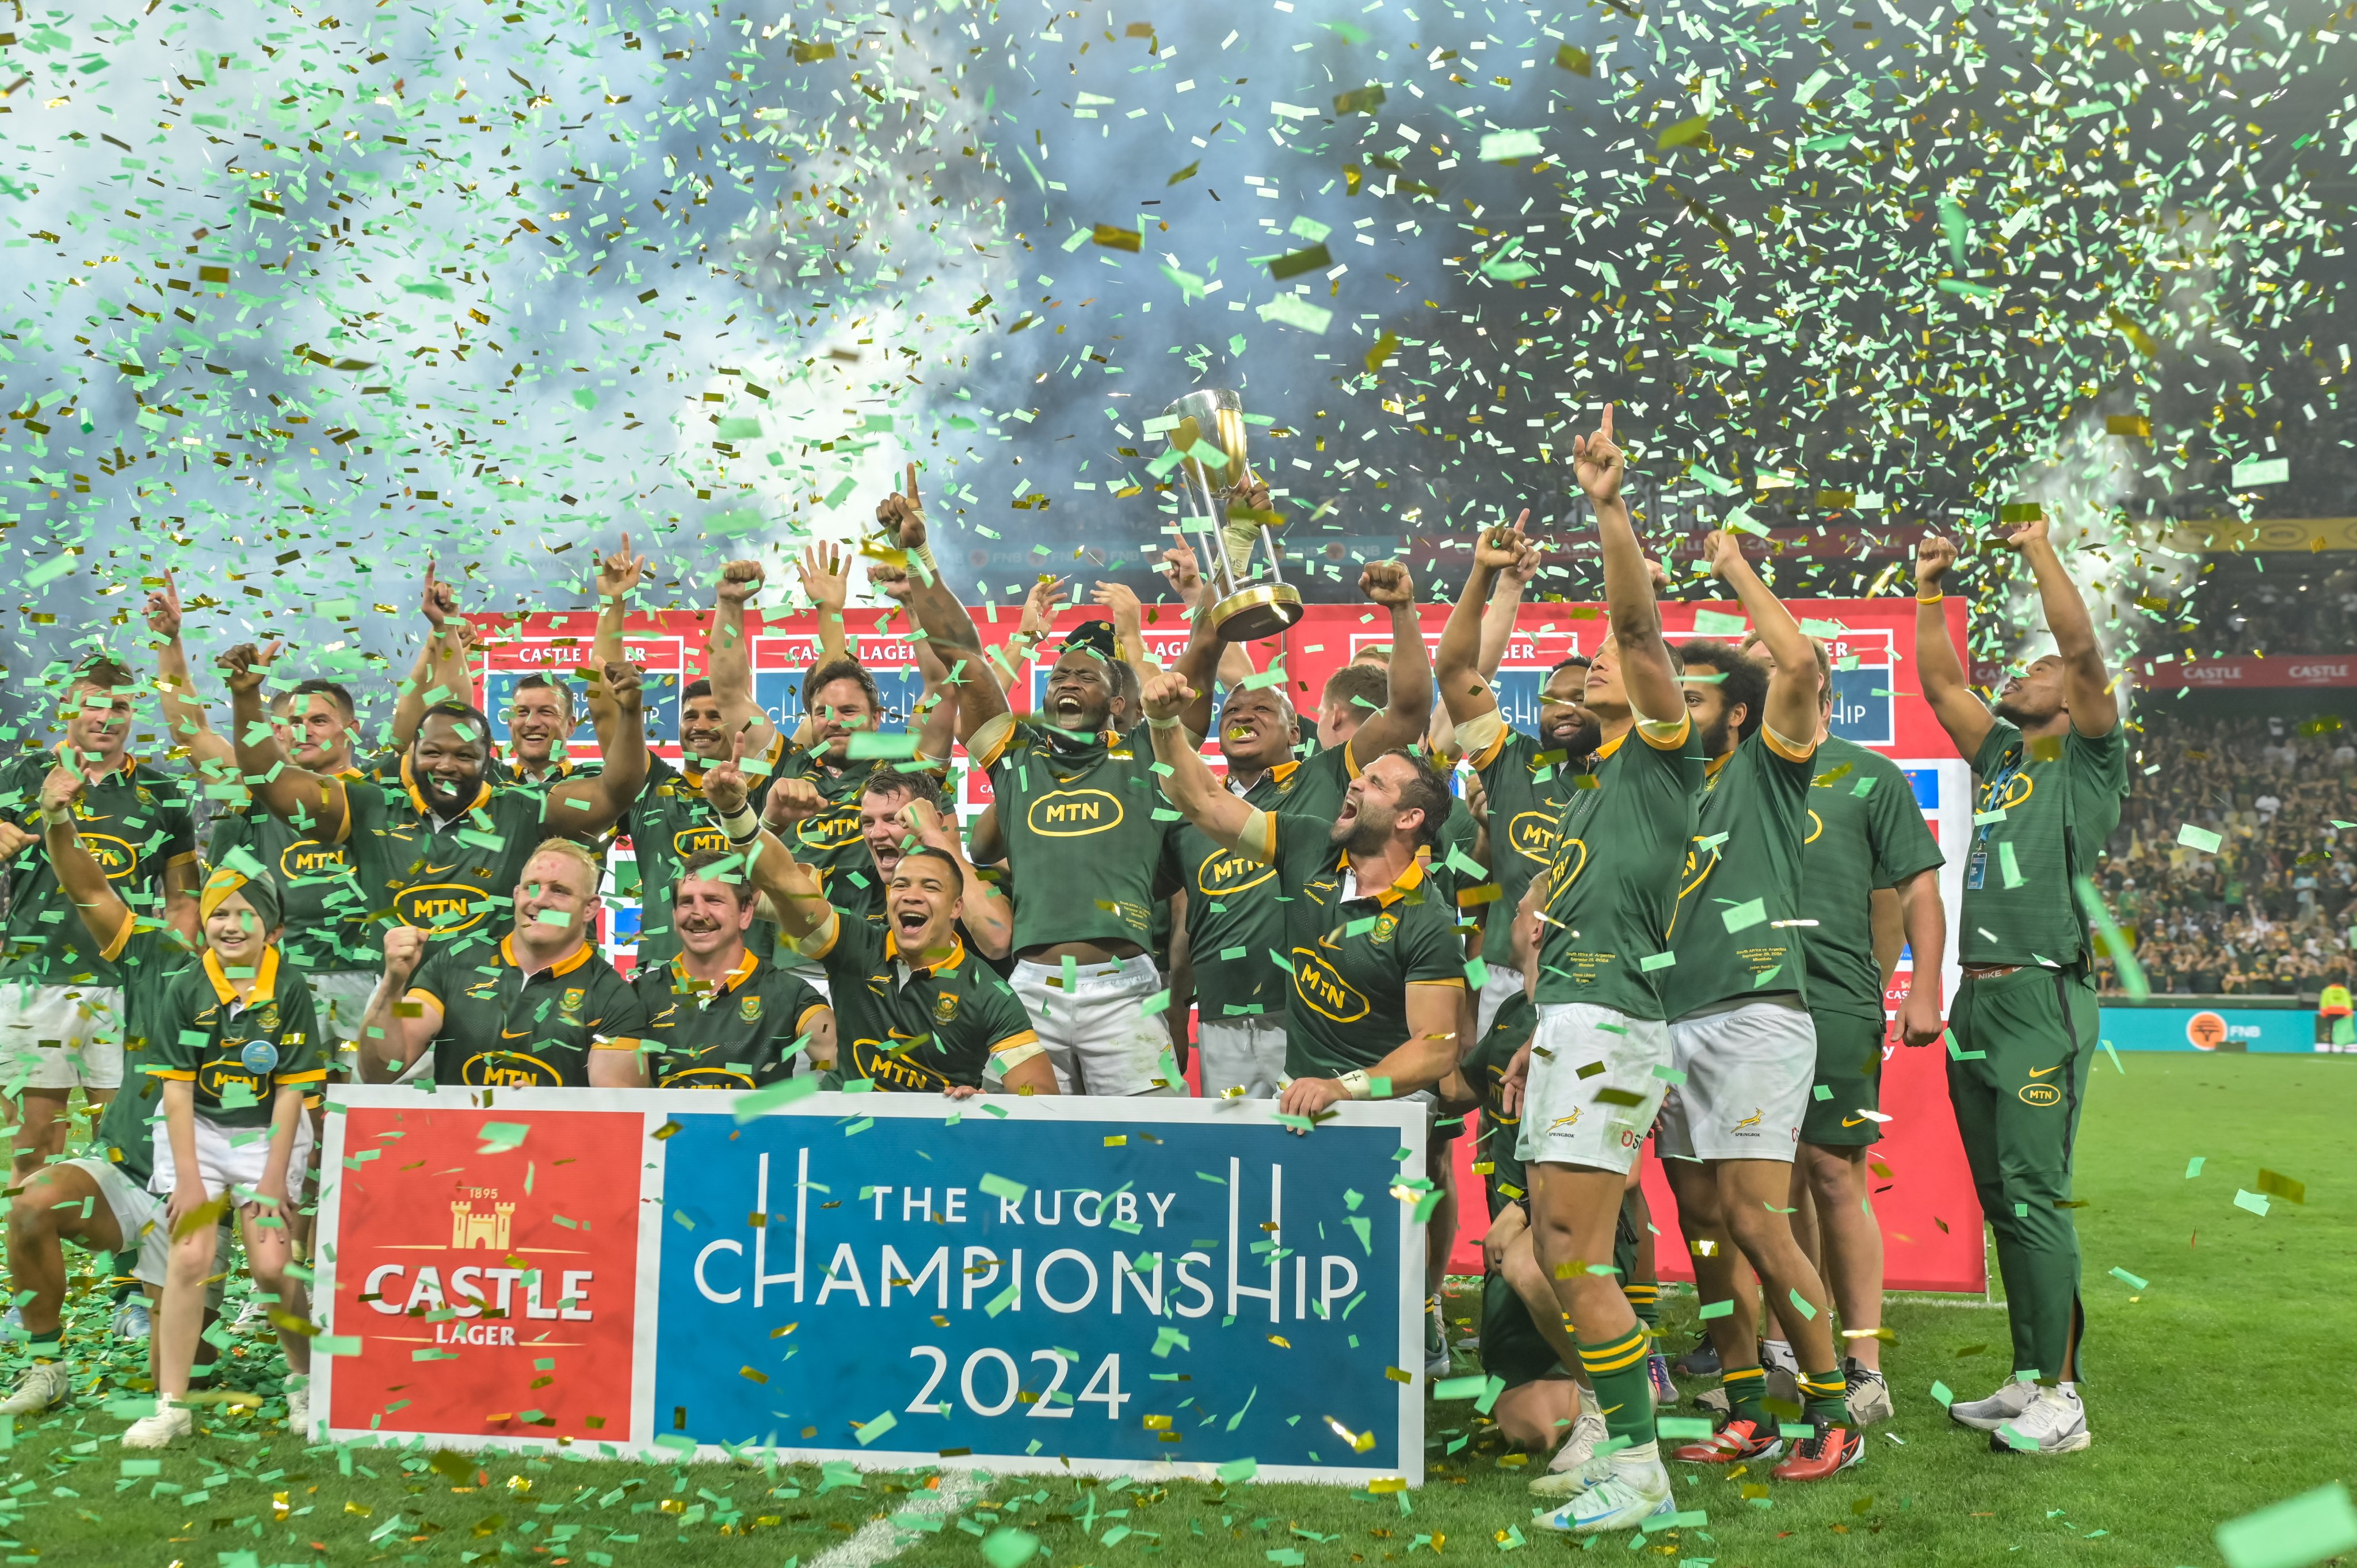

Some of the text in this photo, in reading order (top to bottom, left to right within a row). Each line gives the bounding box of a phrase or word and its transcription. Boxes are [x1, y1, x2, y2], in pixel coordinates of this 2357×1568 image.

[519, 647, 582, 663] CASTLE
[2183, 666, 2242, 680] CASTLE
[2289, 665, 2348, 678] CASTLE
[1046, 802, 1099, 823] MTN
[817, 816, 859, 836] MTN
[1523, 823, 1555, 848] MT
[1303, 887, 1325, 906] SPRINGBOK
[414, 898, 467, 918] MTN
[1978, 969, 2003, 980] NIKE
[1300, 963, 1345, 1009] MTN
[2229, 1025, 2261, 1038] FNB
[483, 1066, 537, 1086] MTN
[869, 1054, 928, 1089] MTN
[2029, 1089, 2052, 1100] MTN
[468, 1187, 498, 1201] 1895
[873, 1185, 1177, 1228] THE RUGBY
[694, 1148, 1359, 1324] CHAMPIONSHIP
[363, 1262, 594, 1322] CASTLE
[436, 1323, 516, 1348] LAGER
[905, 1345, 1132, 1421] 2024
